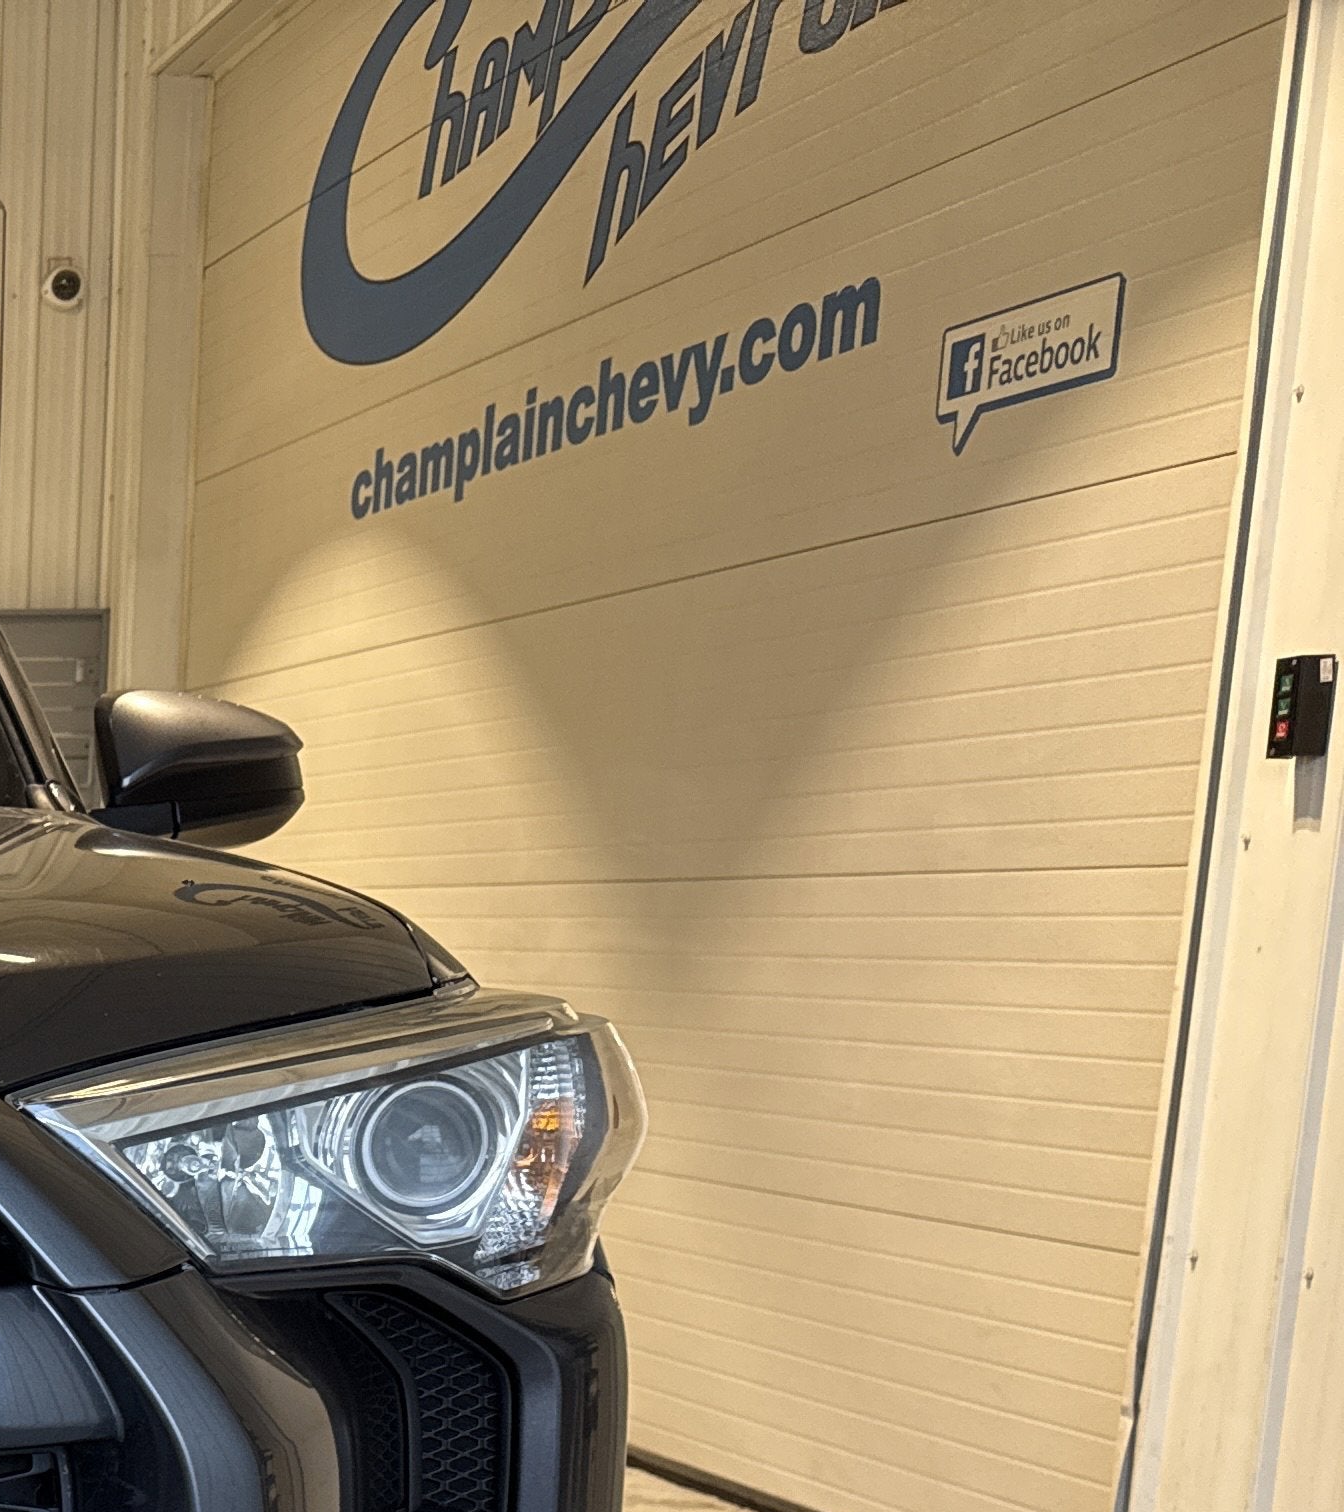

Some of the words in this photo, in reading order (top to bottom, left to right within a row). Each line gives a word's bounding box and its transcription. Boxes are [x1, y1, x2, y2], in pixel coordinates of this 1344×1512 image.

[987, 323, 1102, 389] Facebook
[1010, 324, 1035, 345] Like
[1038, 320, 1052, 336] us
[1054, 314, 1071, 331] on
[351, 275, 883, 520] champlainchevy.com
